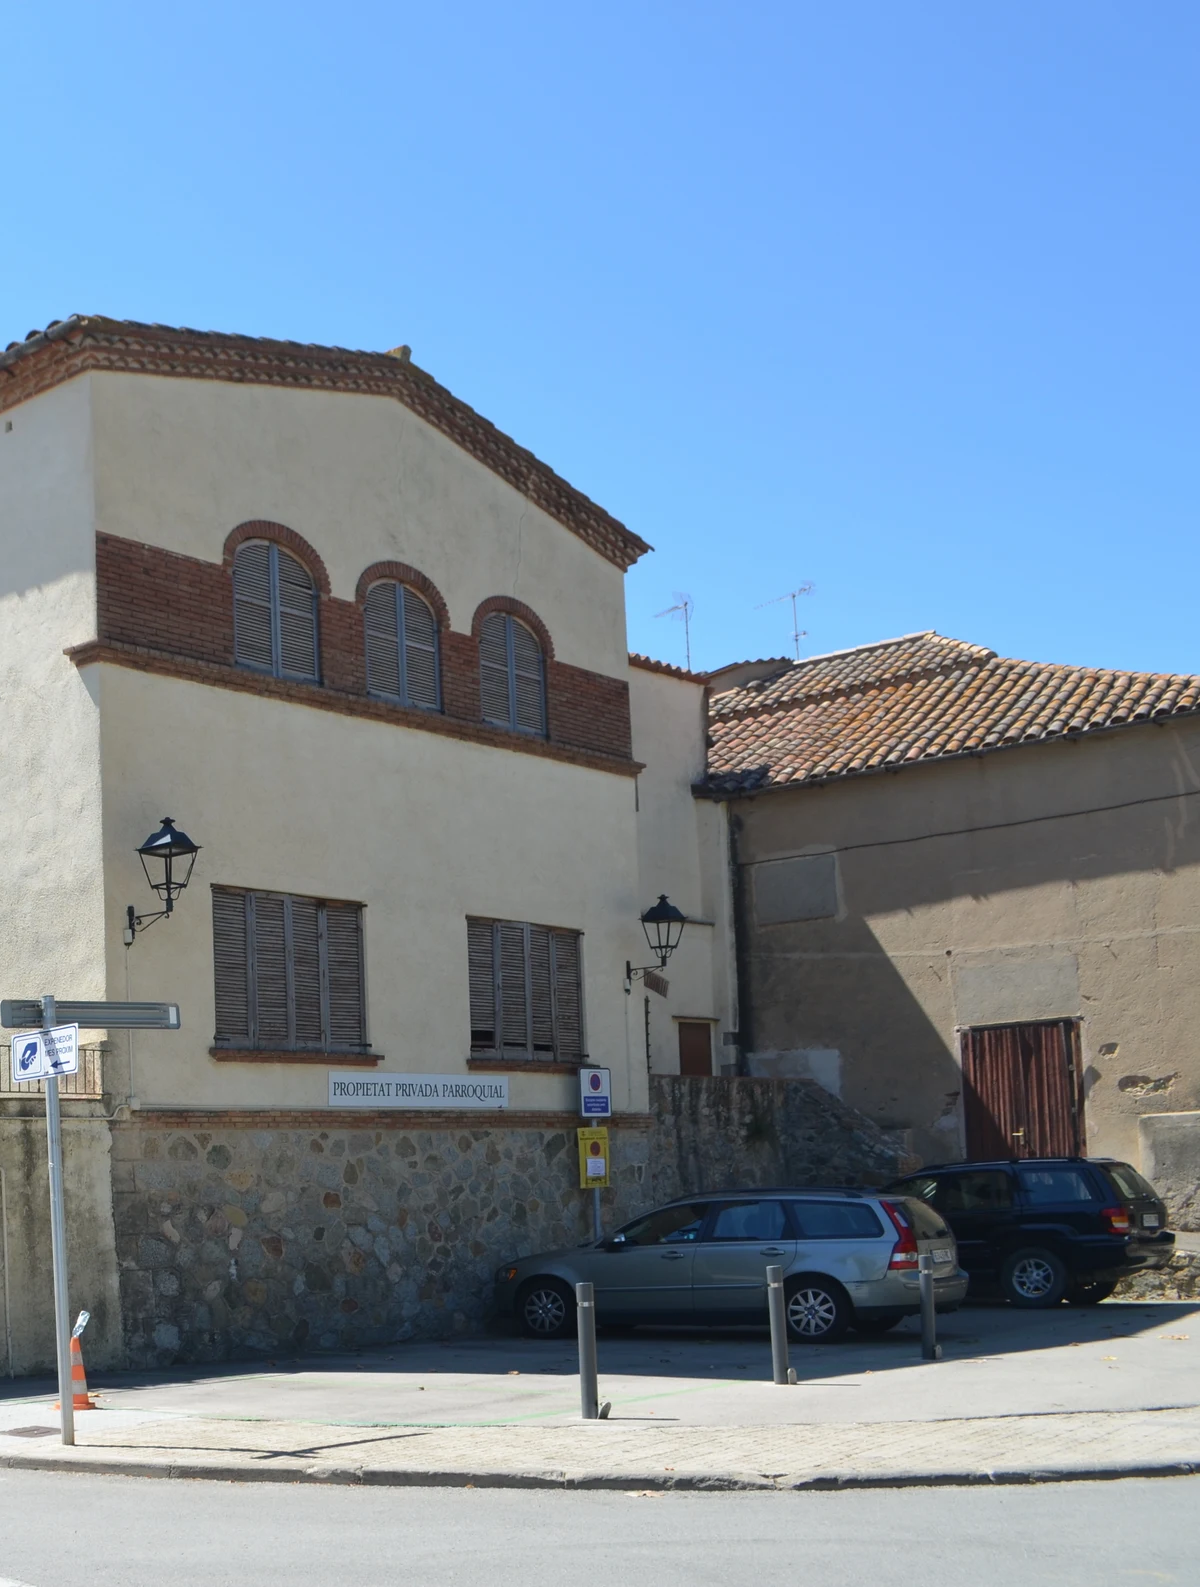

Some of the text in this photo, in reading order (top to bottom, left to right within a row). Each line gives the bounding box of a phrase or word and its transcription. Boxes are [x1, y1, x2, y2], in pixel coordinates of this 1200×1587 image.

[333, 1081, 505, 1102] PROPIETAT PRIVADA PARROQUIAL
